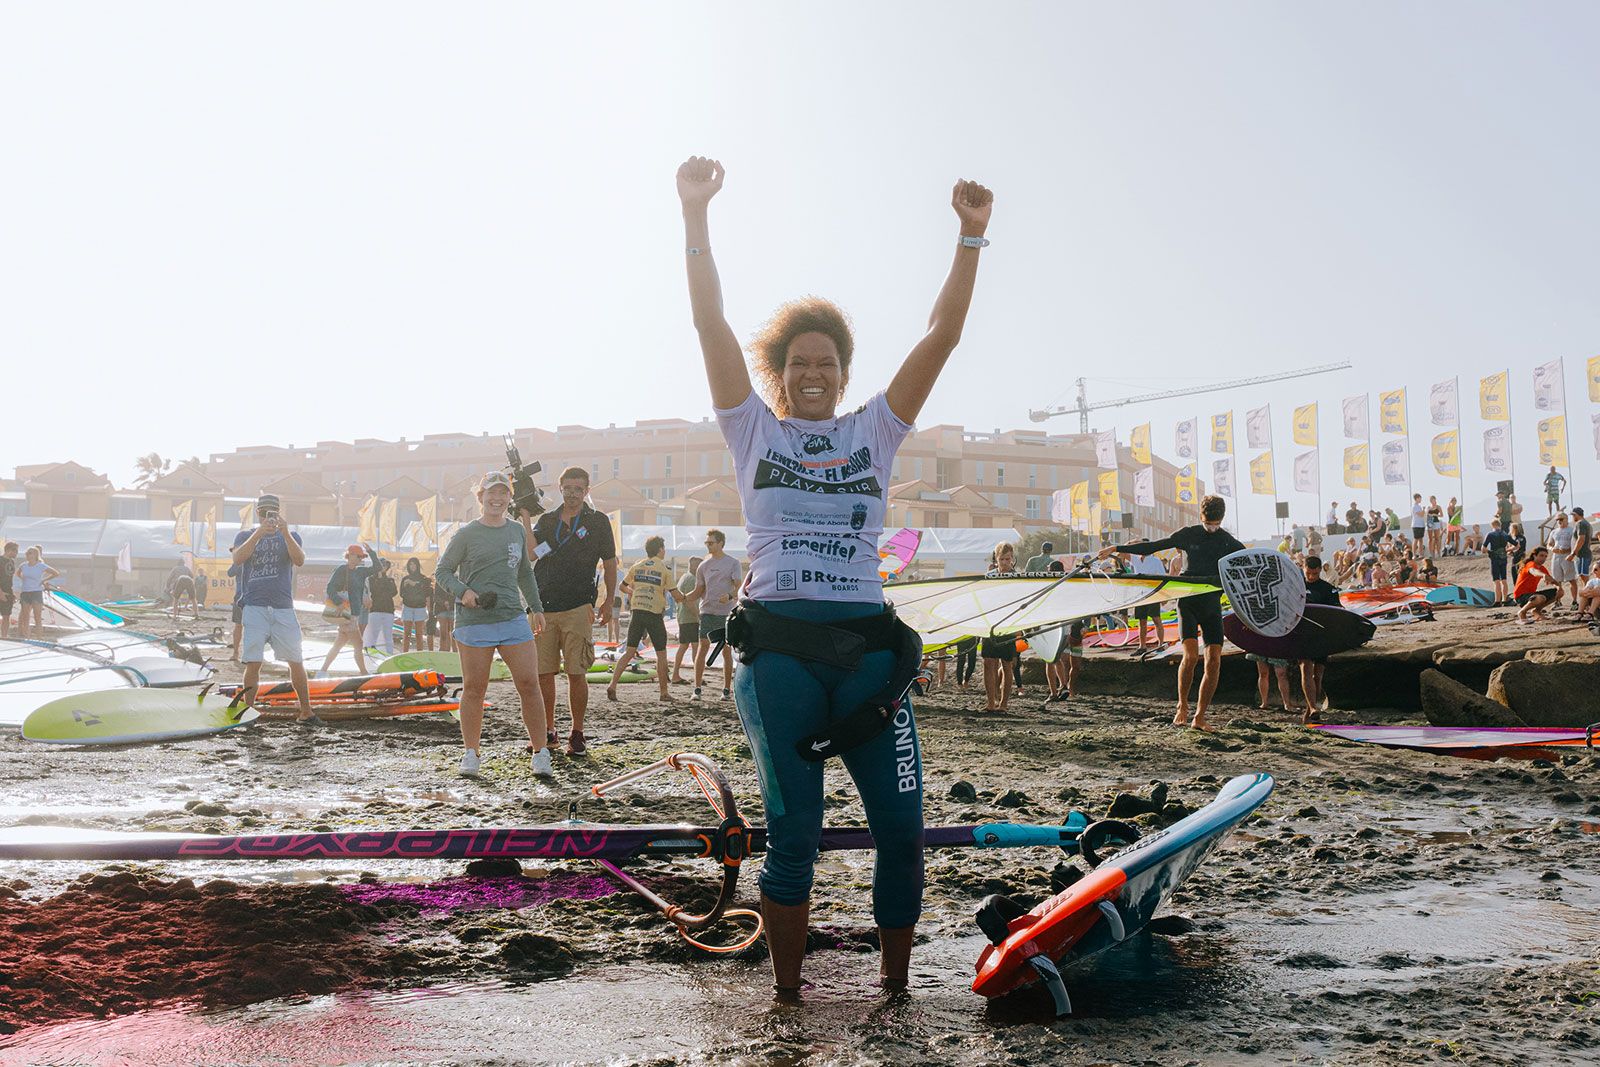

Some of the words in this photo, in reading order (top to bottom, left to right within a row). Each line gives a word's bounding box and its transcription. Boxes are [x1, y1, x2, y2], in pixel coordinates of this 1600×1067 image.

[769, 468, 825, 493] PLAYA
[211, 579, 234, 588] BRU
[893, 699, 917, 793] BRUNO
